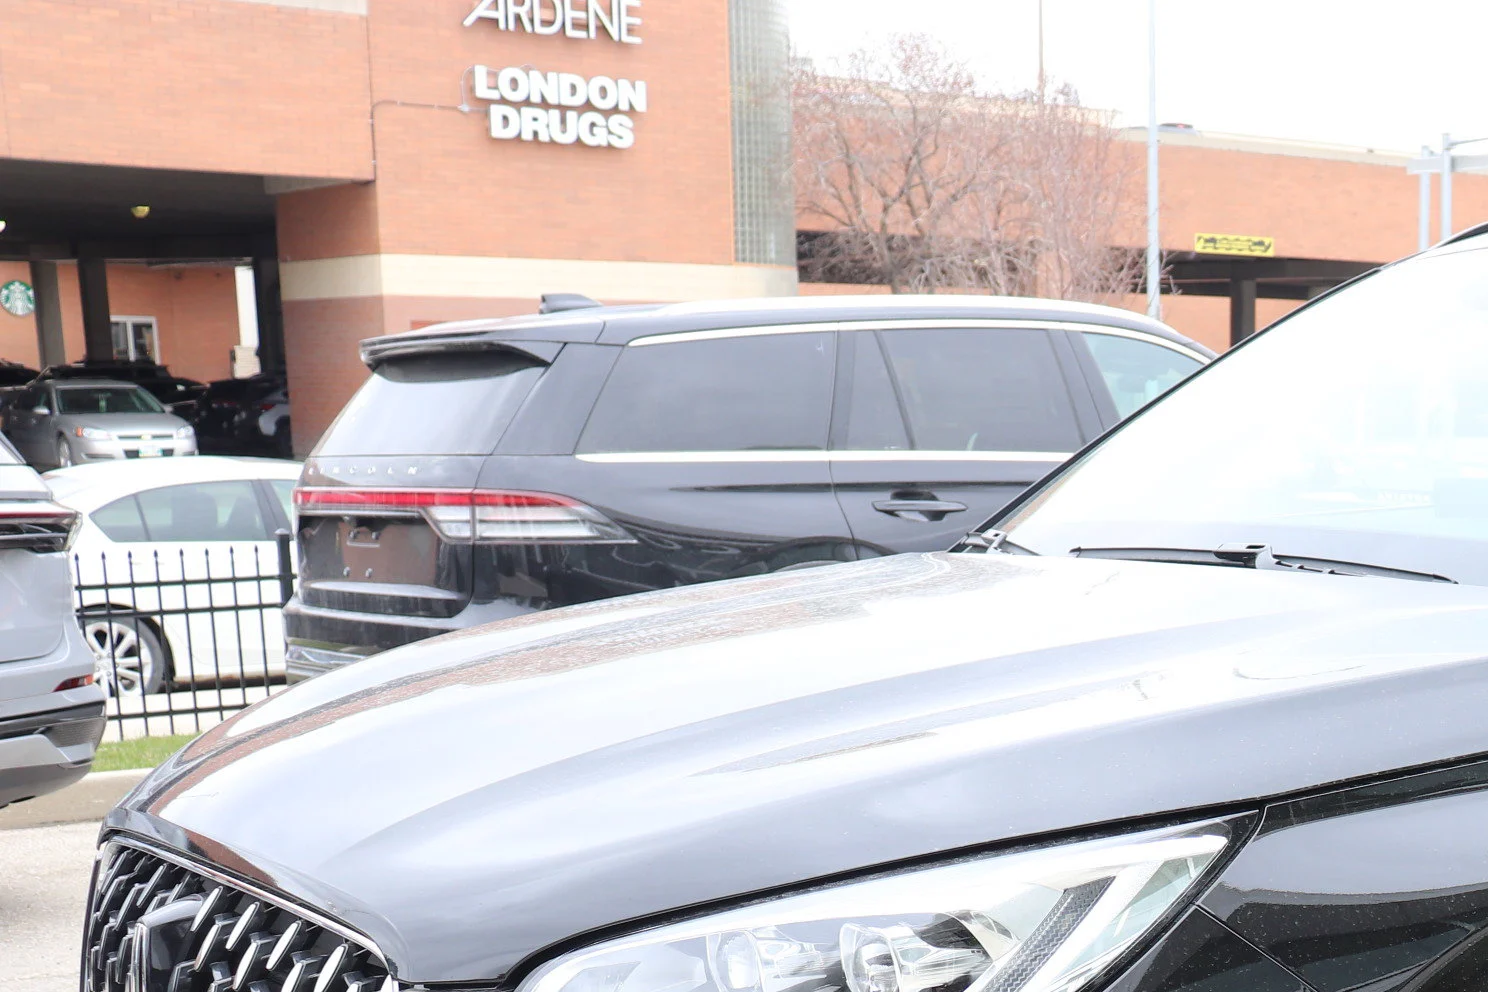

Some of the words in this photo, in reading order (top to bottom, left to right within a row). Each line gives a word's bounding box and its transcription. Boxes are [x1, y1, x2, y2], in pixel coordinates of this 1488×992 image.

[463, 0, 642, 43] ARDENE
[474, 64, 647, 112] LONDON
[489, 104, 635, 149] DRUGS
[307, 465, 418, 475] LINCOLN
